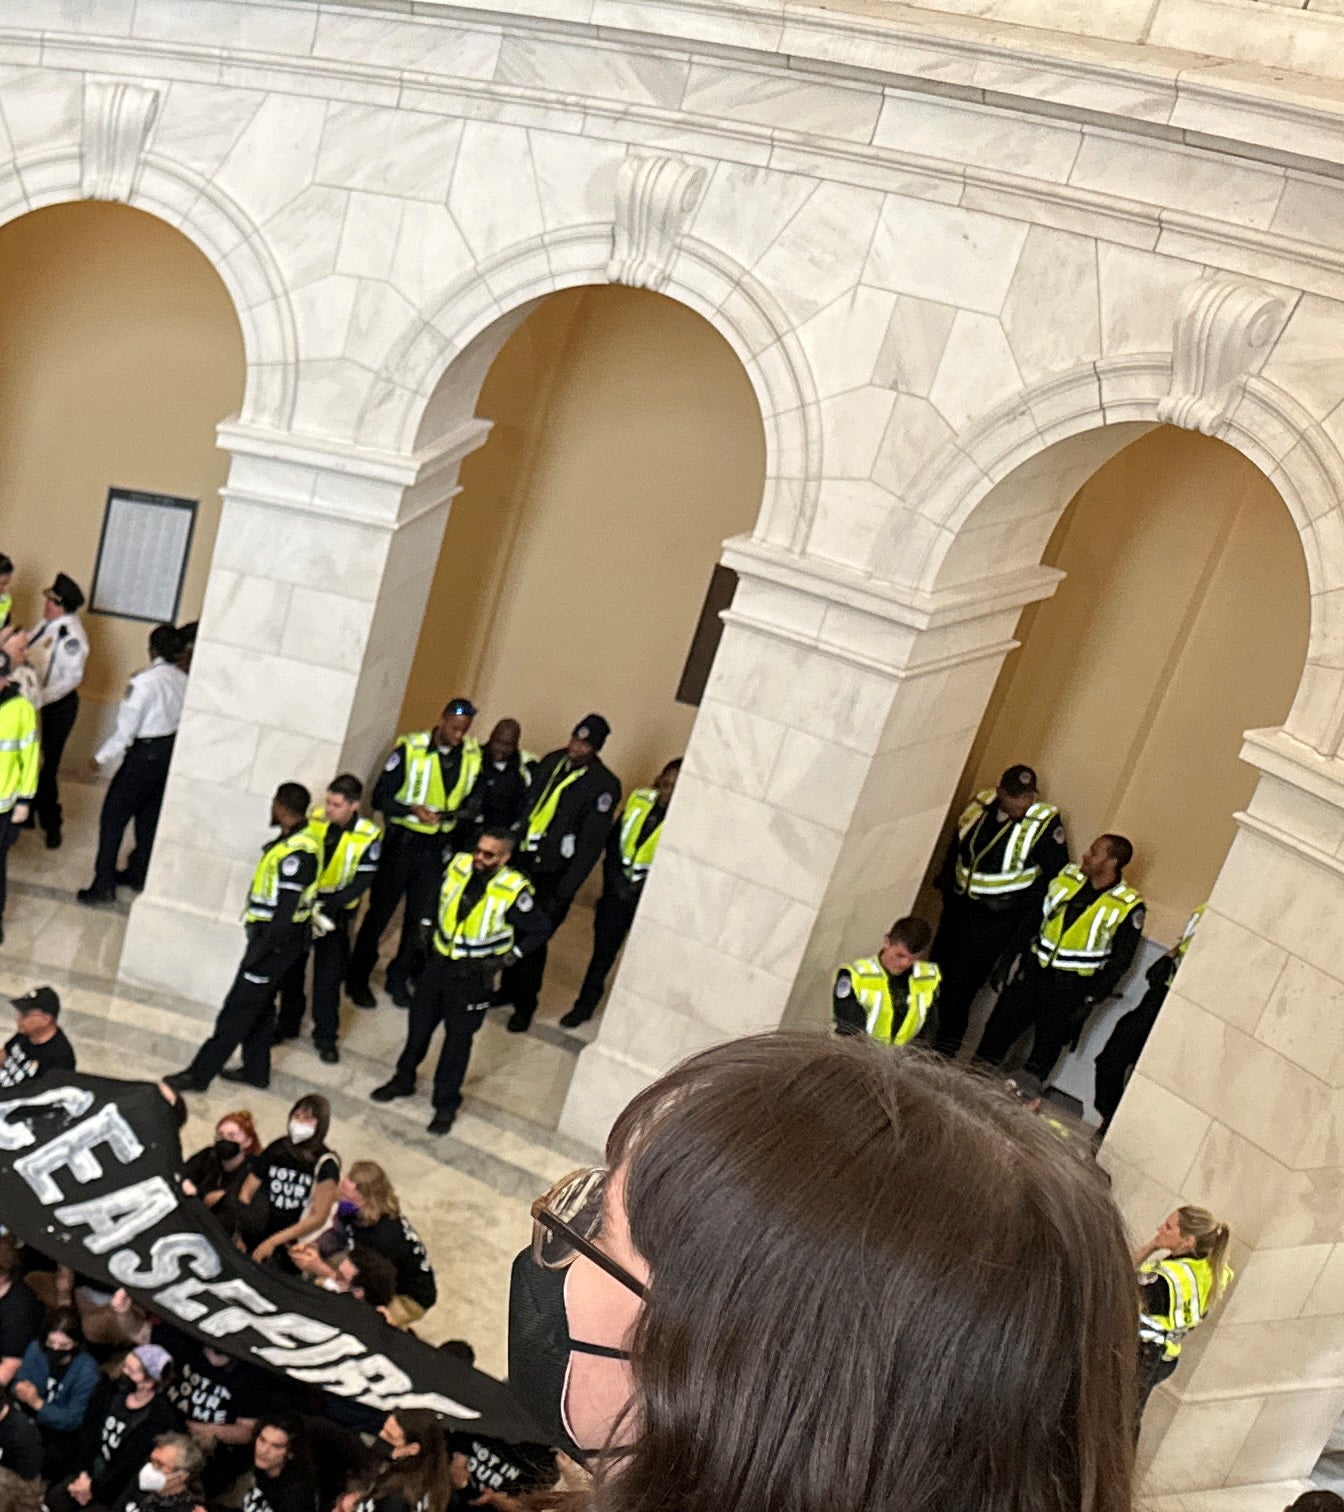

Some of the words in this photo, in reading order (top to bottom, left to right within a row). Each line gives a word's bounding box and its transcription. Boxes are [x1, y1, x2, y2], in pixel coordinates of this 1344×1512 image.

[268, 1165, 298, 1182] NOT
[270, 1178, 307, 1197] OUR
[182, 1363, 212, 1391] NOT
[167, 1385, 229, 1425] NAME
[179, 1380, 222, 1412] OUR
[499, 1462, 521, 1482] IN
